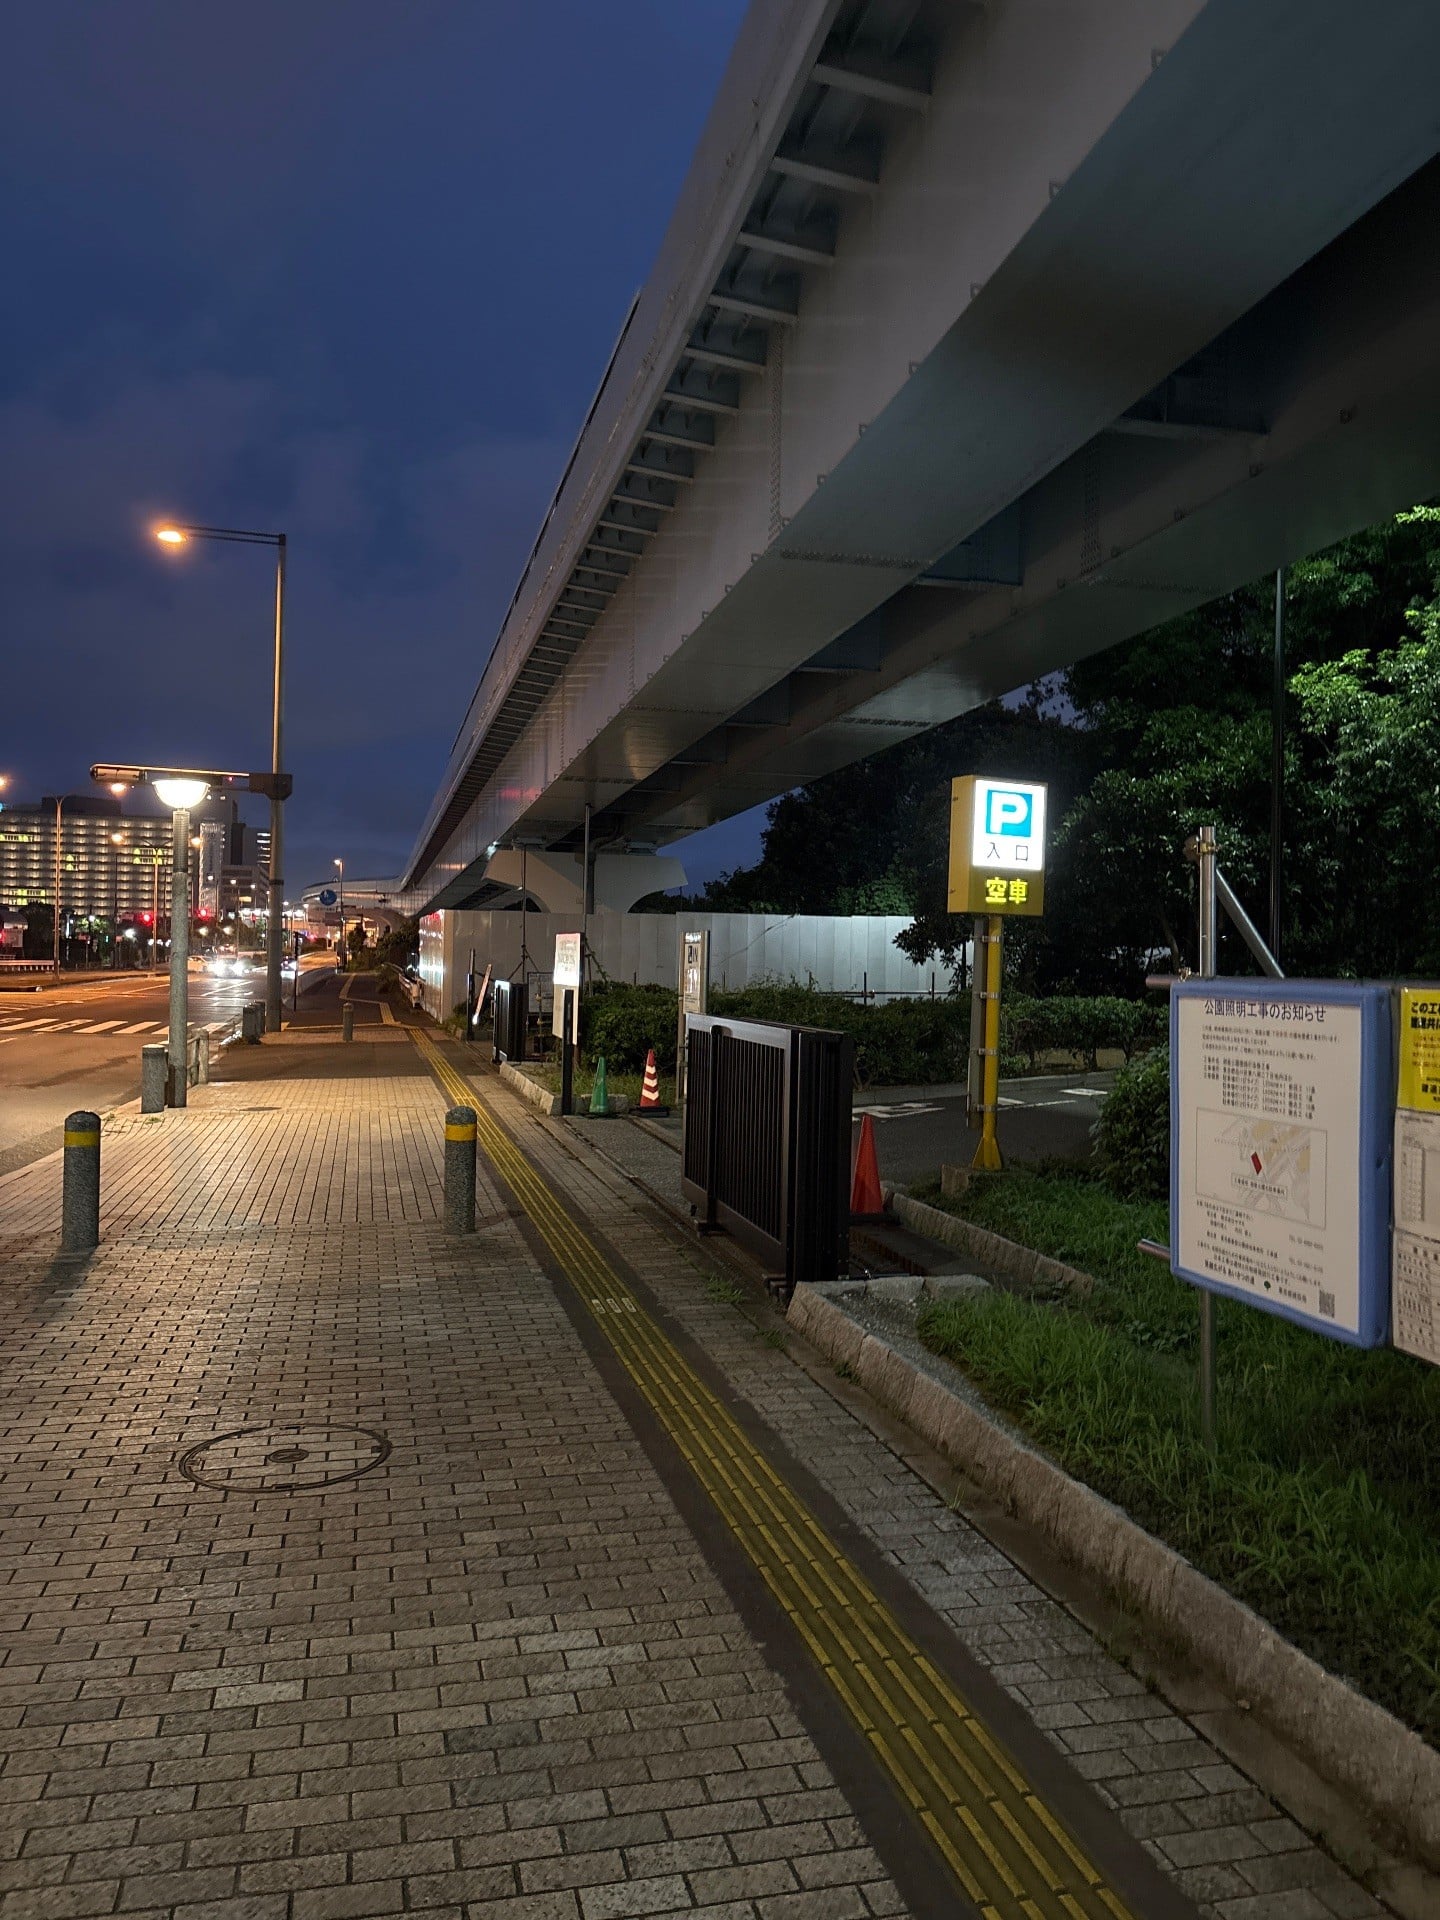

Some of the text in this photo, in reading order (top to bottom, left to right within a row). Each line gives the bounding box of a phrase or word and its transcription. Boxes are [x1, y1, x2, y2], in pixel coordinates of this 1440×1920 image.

[989, 790, 1029, 833] P
[986, 842, 1029, 862] 入口
[985, 876, 1028, 905] 空車
[1204, 998, 1327, 1023] 公園照明工事のお知らせ
[1411, 1001, 1440, 1014] この工
